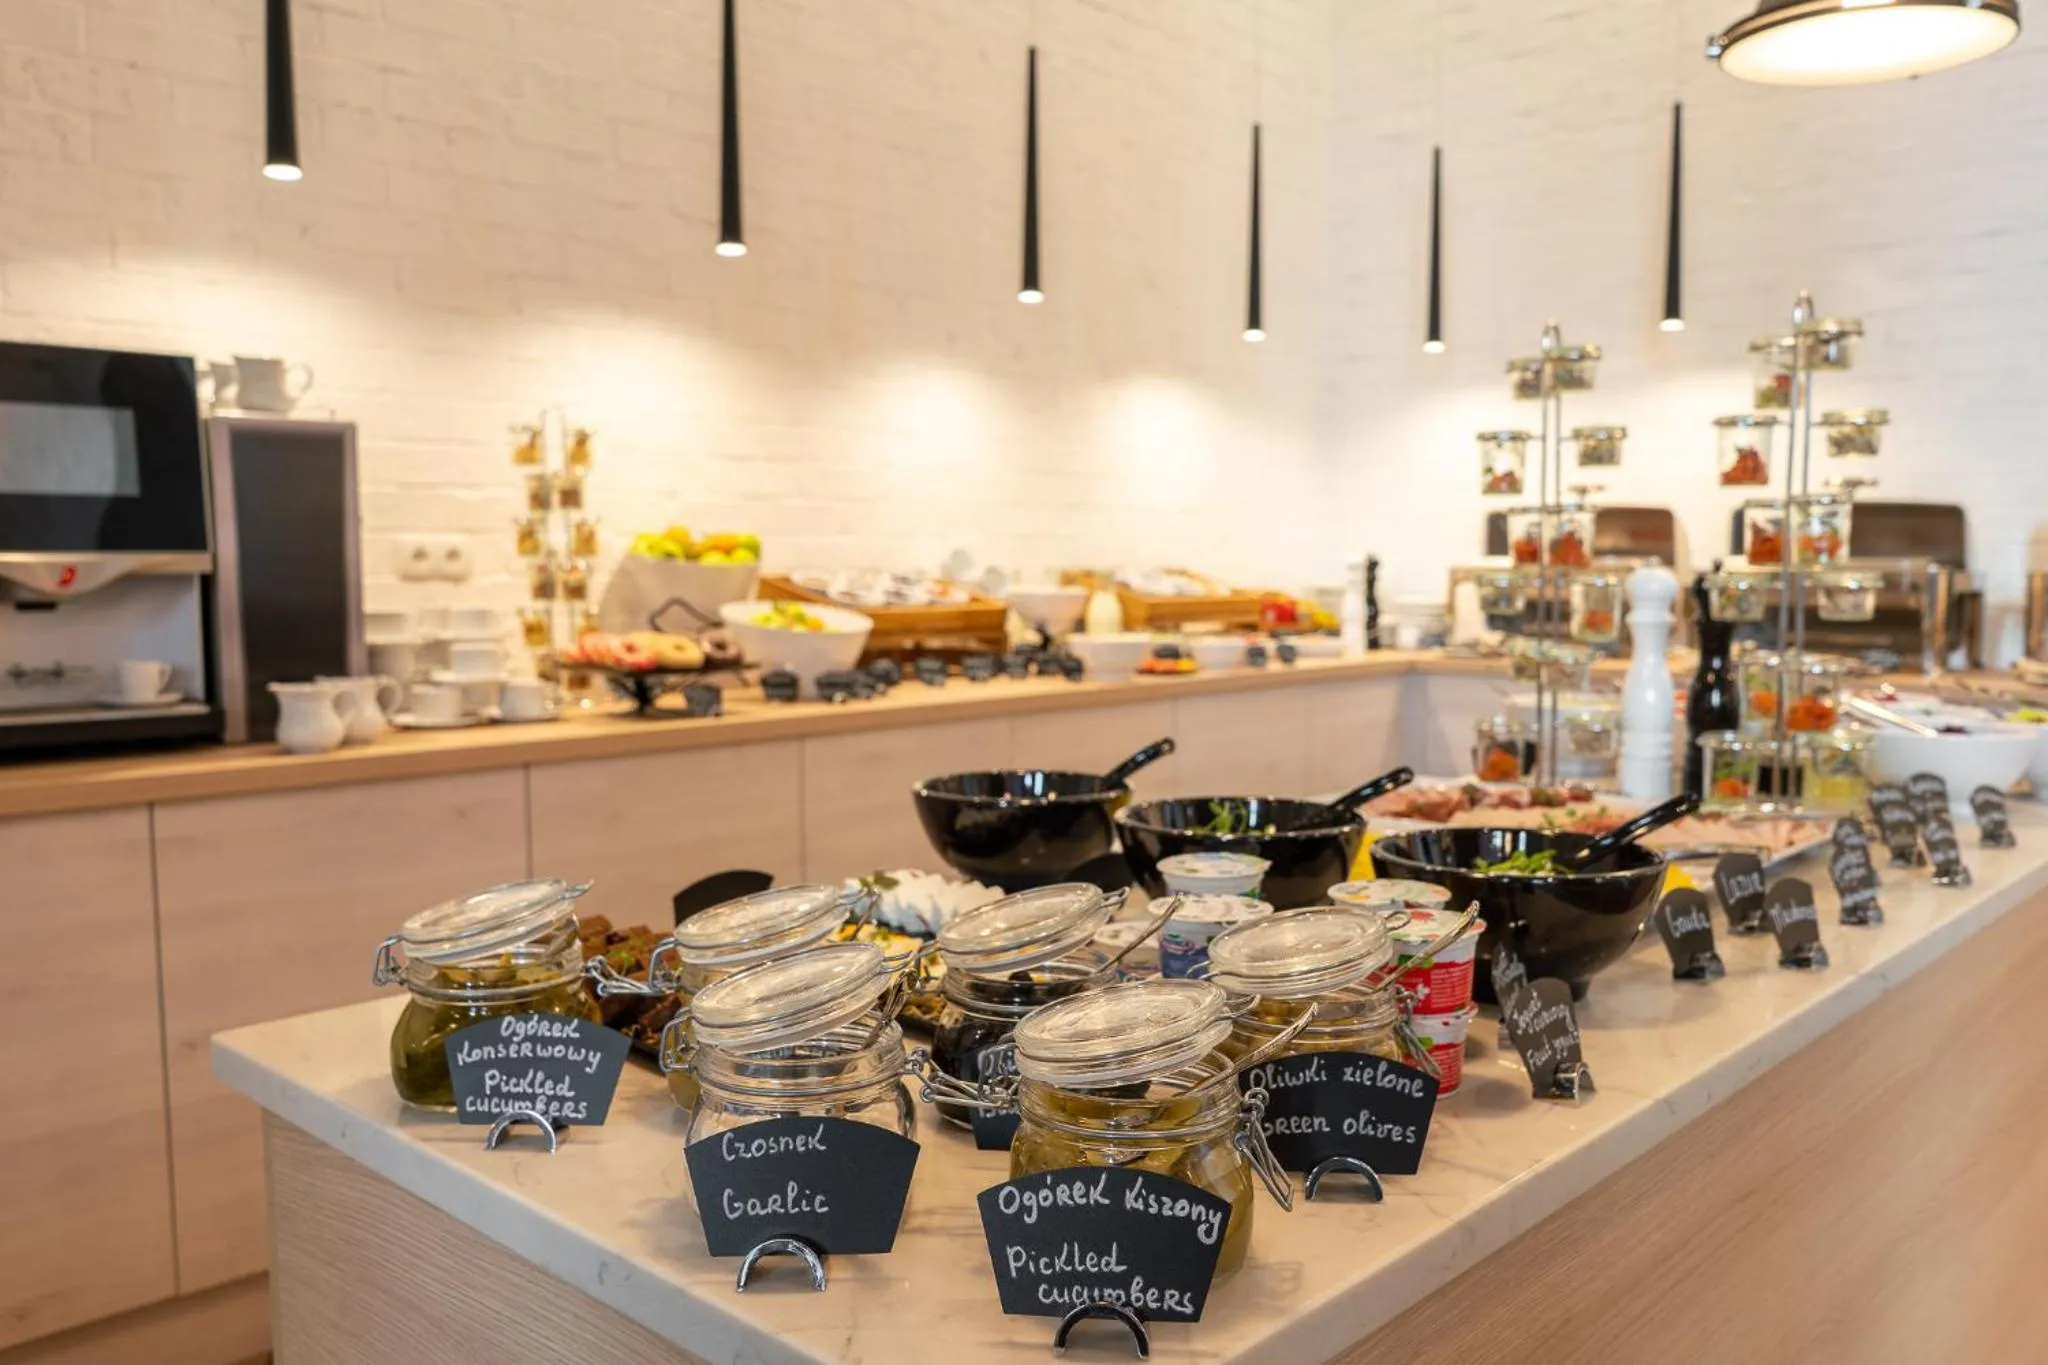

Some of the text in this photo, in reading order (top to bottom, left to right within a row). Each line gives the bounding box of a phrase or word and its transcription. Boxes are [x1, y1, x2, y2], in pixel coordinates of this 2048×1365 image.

[484, 1068, 576, 1095] Pickled
[1250, 1055, 1328, 1090] Oliwki
[1342, 1060, 1425, 1099] zielone
[465, 1096, 588, 1119] cucumbers
[1342, 1109, 1417, 1144] olives
[721, 1123, 828, 1162] Czosnek
[722, 1179, 830, 1220] Garlic
[1005, 1241, 1129, 1279] Pickled
